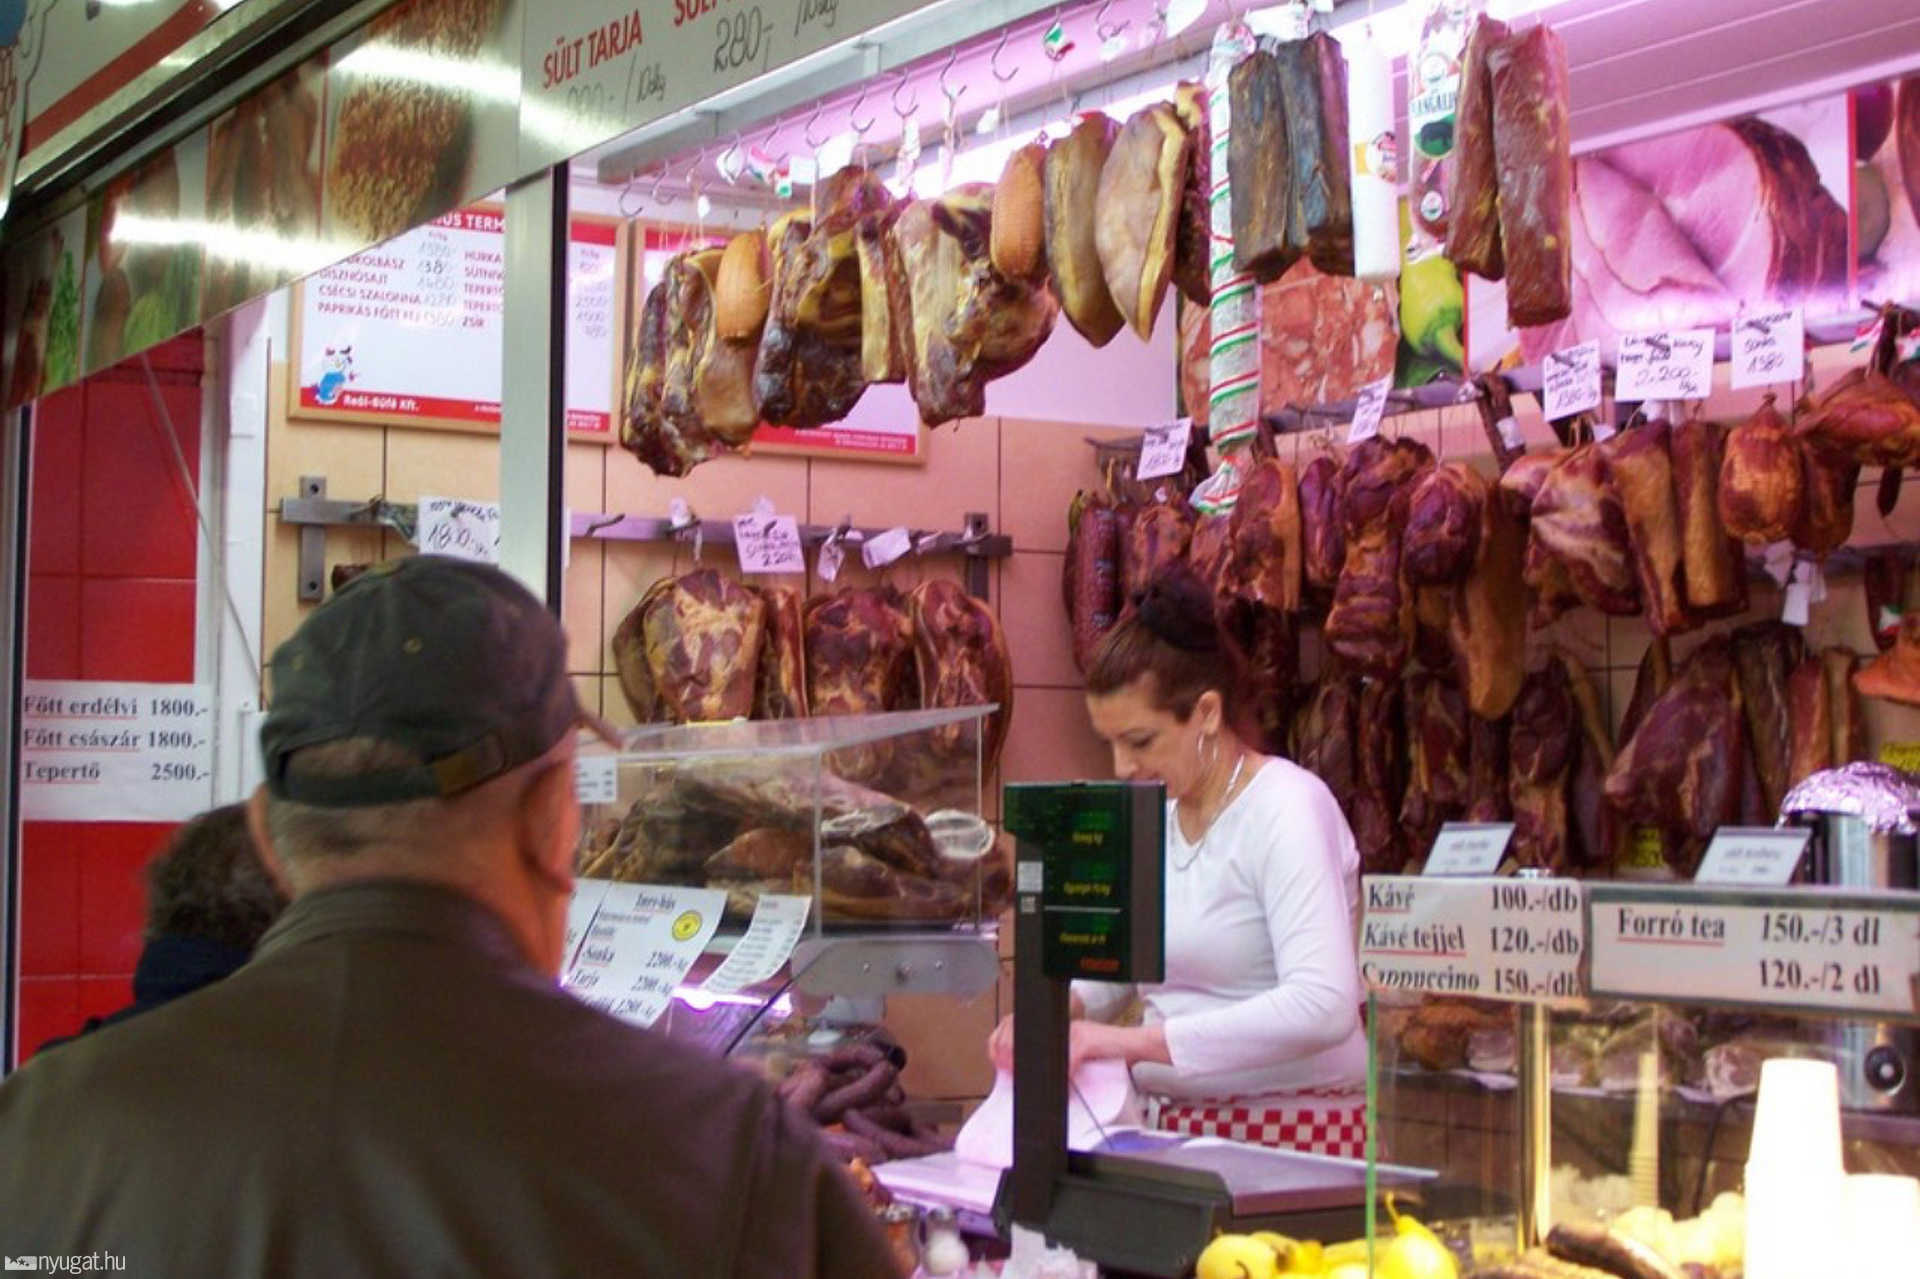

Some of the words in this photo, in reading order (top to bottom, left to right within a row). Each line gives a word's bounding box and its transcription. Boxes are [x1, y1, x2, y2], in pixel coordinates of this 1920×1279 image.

[542, 35, 584, 89] SÜLT
[587, 8, 643, 69] TARJA
[23, 697, 62, 716] Főtt
[23, 728, 62, 747] Főtt
[69, 728, 140, 747] császár
[24, 762, 101, 782] Tepertő
[1368, 884, 1414, 909] Kávé
[1490, 886, 1578, 912] 100.-/db
[1364, 923, 1409, 948] Kávé
[1413, 923, 1465, 955] tejjel
[1490, 926, 1579, 953] 120.-/db
[1618, 907, 1684, 936] Forró
[1691, 915, 1725, 939] tea
[1761, 912, 1844, 943] 150.-/3
[1853, 917, 1880, 946] dl
[1759, 959, 1844, 992] 120.-/2
[1853, 965, 1880, 995] dl
